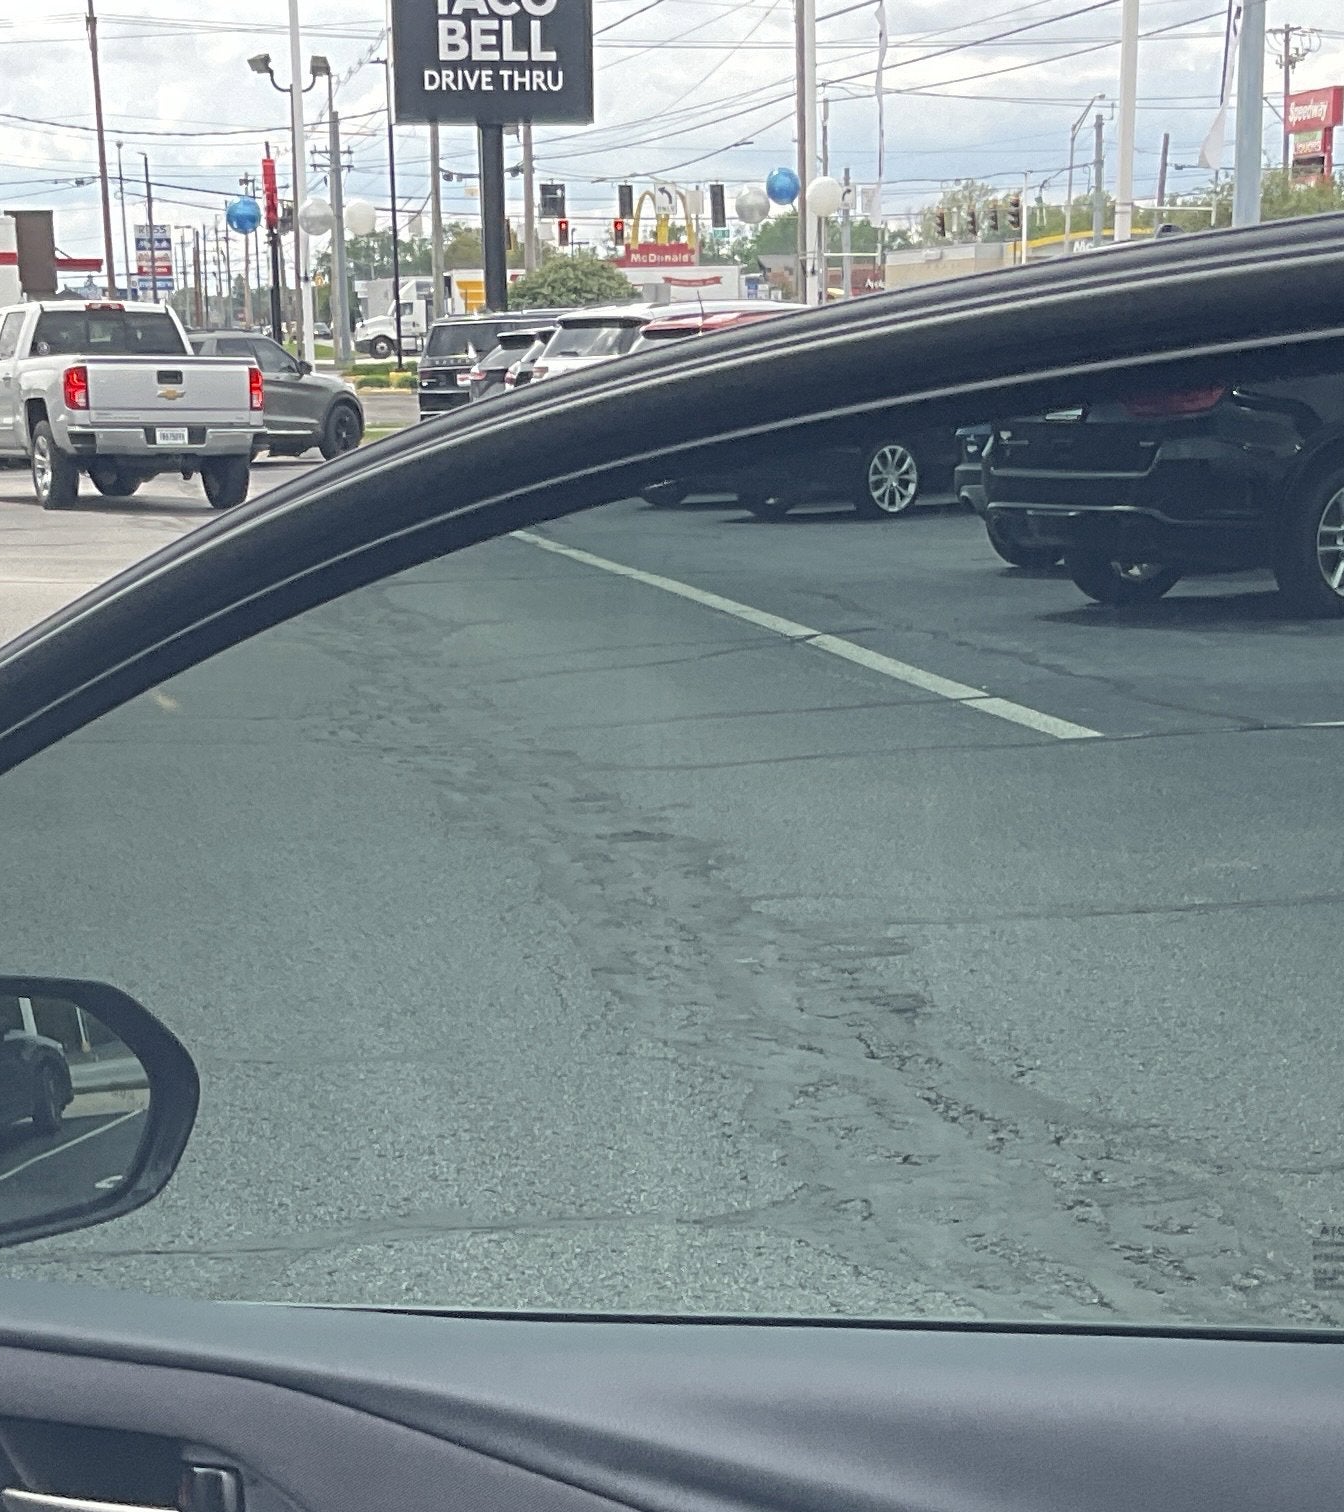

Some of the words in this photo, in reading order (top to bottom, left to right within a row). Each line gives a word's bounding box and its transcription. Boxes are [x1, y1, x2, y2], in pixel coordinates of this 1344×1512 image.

[438, 19, 557, 62] BELL
[424, 69, 494, 91] DRIVE
[500, 69, 564, 91] THRU
[1289, 98, 1328, 127] Speedway
